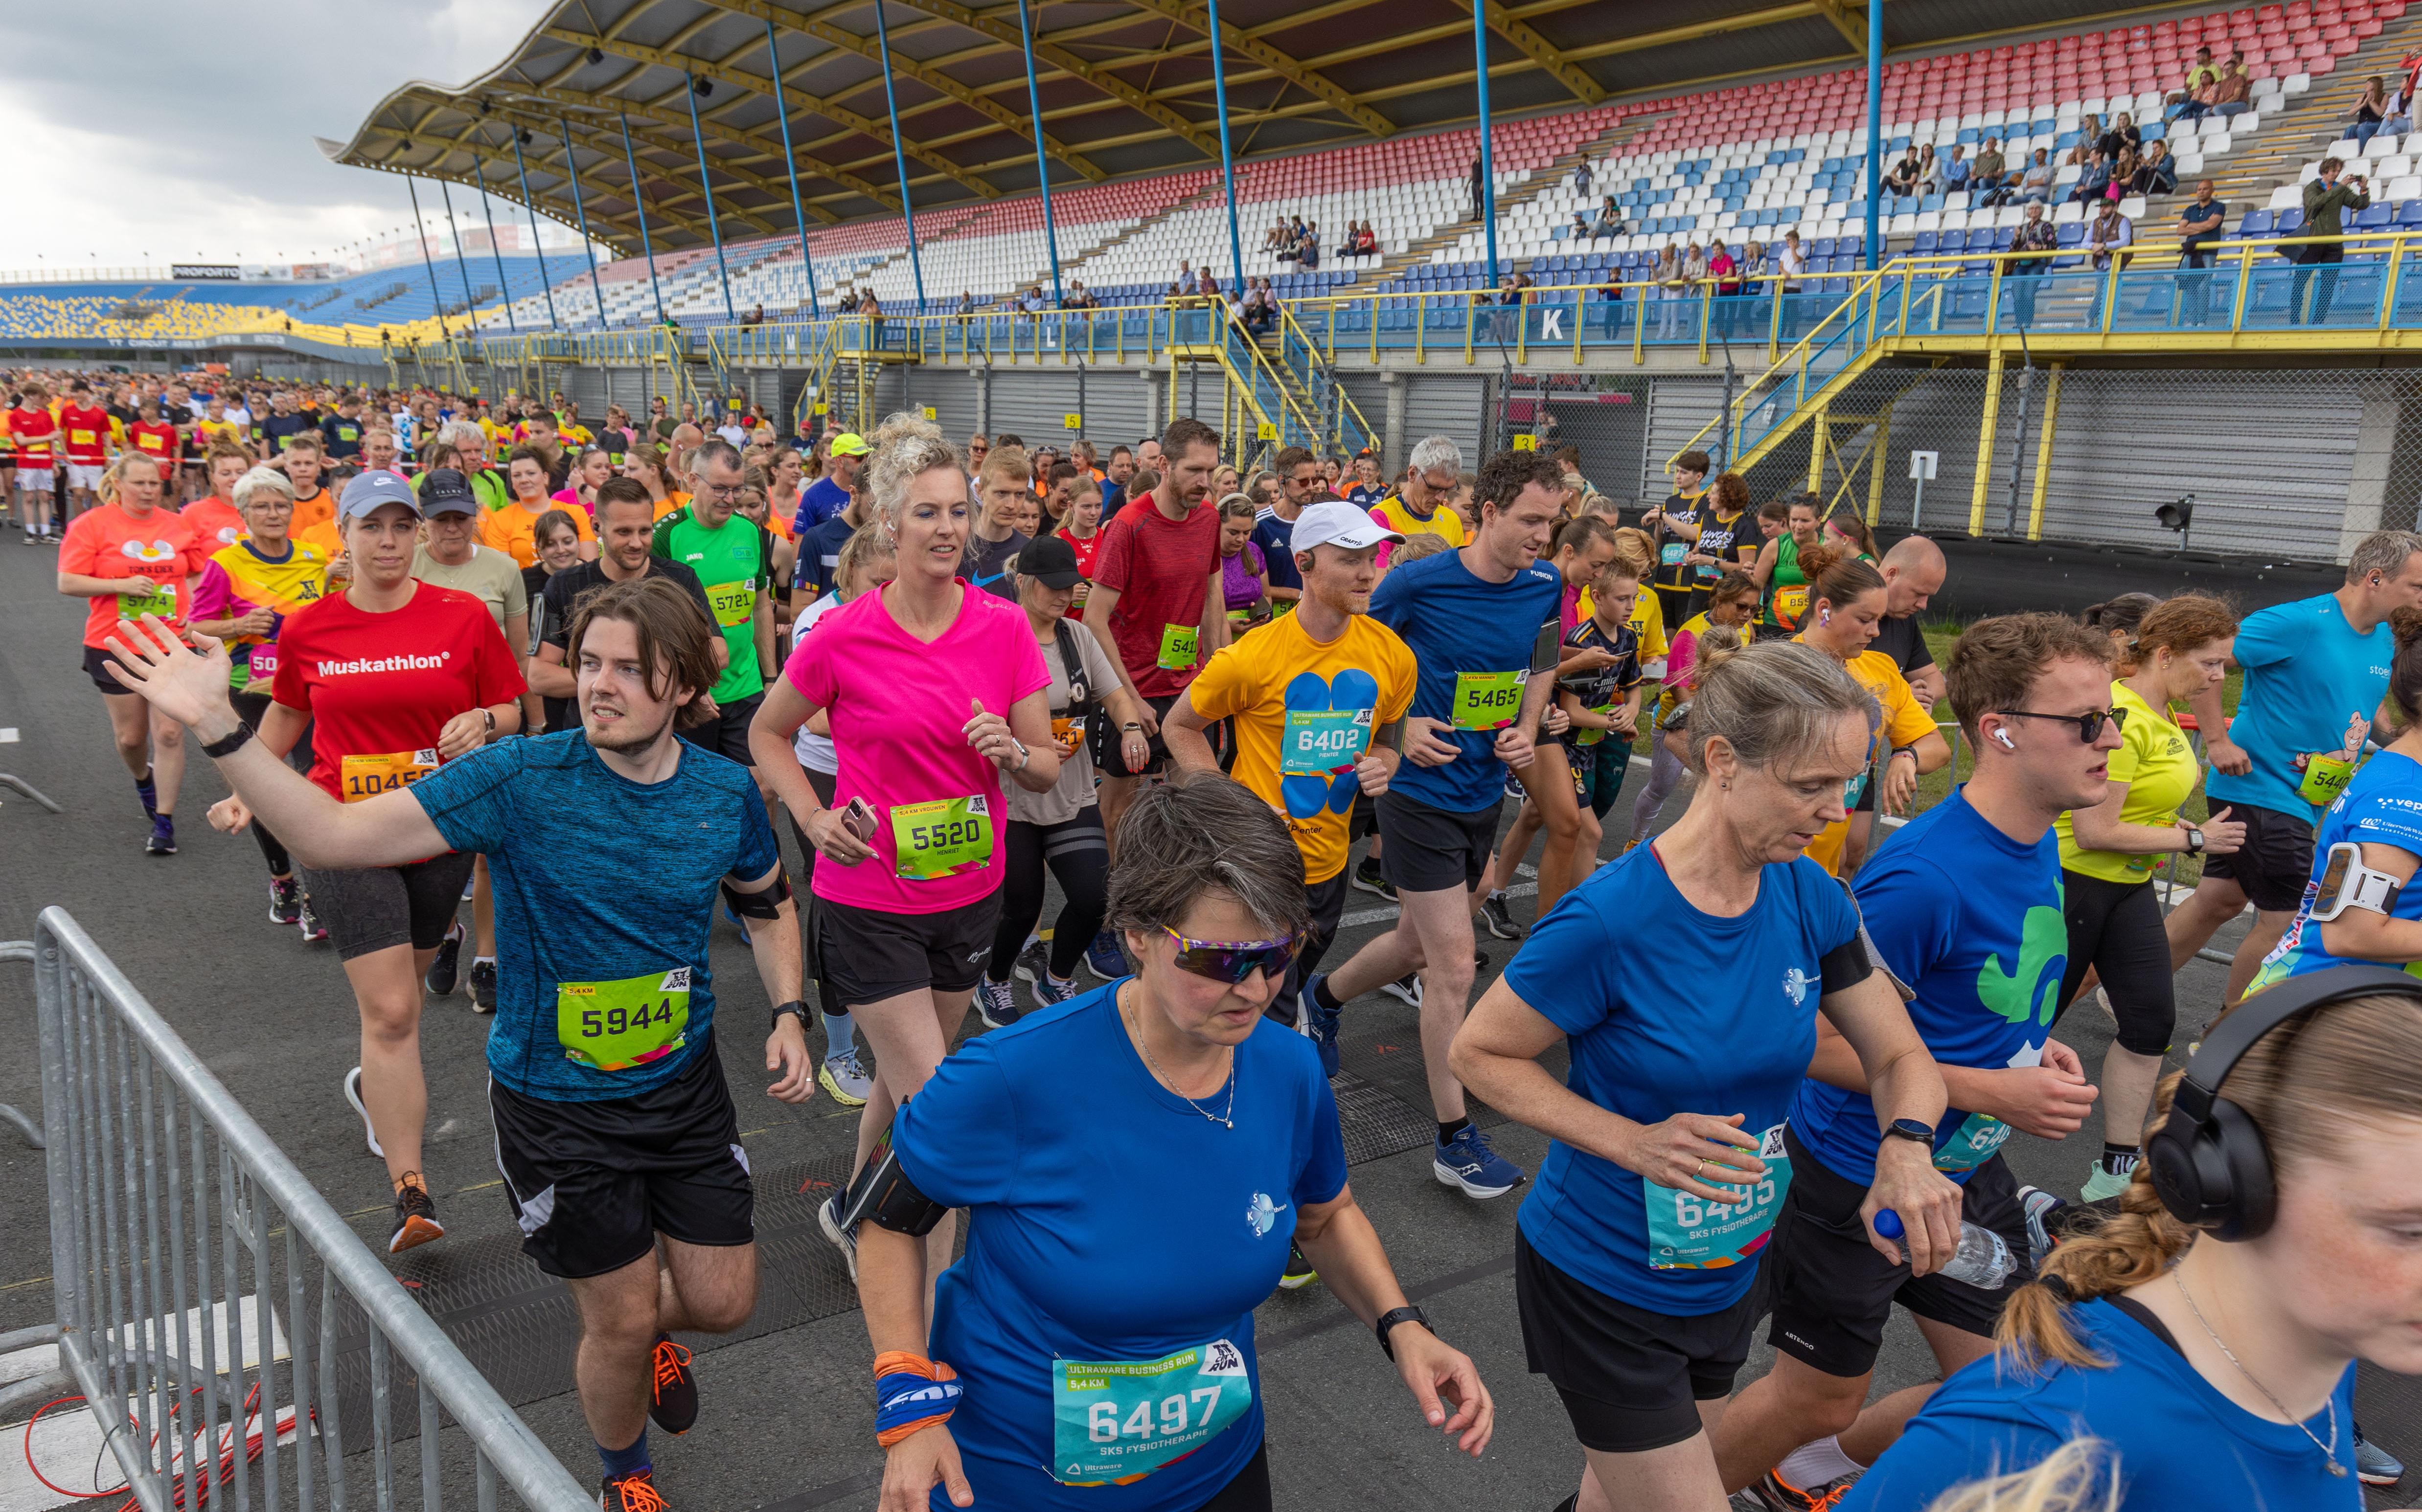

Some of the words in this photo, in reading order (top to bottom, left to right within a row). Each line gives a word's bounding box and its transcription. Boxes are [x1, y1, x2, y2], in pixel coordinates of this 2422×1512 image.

[1542, 309, 1563, 339] K
[787, 334, 795, 350] M
[1047, 326, 1055, 347] L
[925, 409, 932, 419] 6
[1070, 416, 1075, 428] 5
[1263, 426, 1270, 438] 4
[1522, 438, 1529, 450] 3
[1340, 537, 1358, 545] CRAFT
[1531, 570, 1553, 581] FUSION
[127, 595, 167, 607] 5774
[716, 593, 751, 610] 5721
[1468, 687, 1518, 708] 5465
[1298, 729, 1359, 751] 6402
[2314, 771, 2350, 790] 5440
[912, 819, 980, 850] 5520
[582, 998, 673, 1038] 5944
[1675, 1166, 1775, 1228] 6495
[1690, 1229, 1709, 1240] SKS
[1712, 1208, 1768, 1237] FYSIOTHERAPIE
[1677, 1246, 1710, 1255] Ultraware
[1785, 1331, 1814, 1350] ARTENGO
[1070, 1366, 1126, 1375] ULTRAWARE
[1129, 1360, 1174, 1375] BUSINESS
[1176, 1354, 1194, 1367] RUN
[1208, 1357, 1239, 1373] RUN
[1071, 1380, 1087, 1391] 5,4
[1089, 1379, 1105, 1388] KM
[1088, 1385, 1221, 1443] 6497
[1100, 1447, 1123, 1456] SKS
[1126, 1428, 1209, 1454] FYSIOTHERAPIE
[1084, 1463, 1122, 1471] Ultraware
